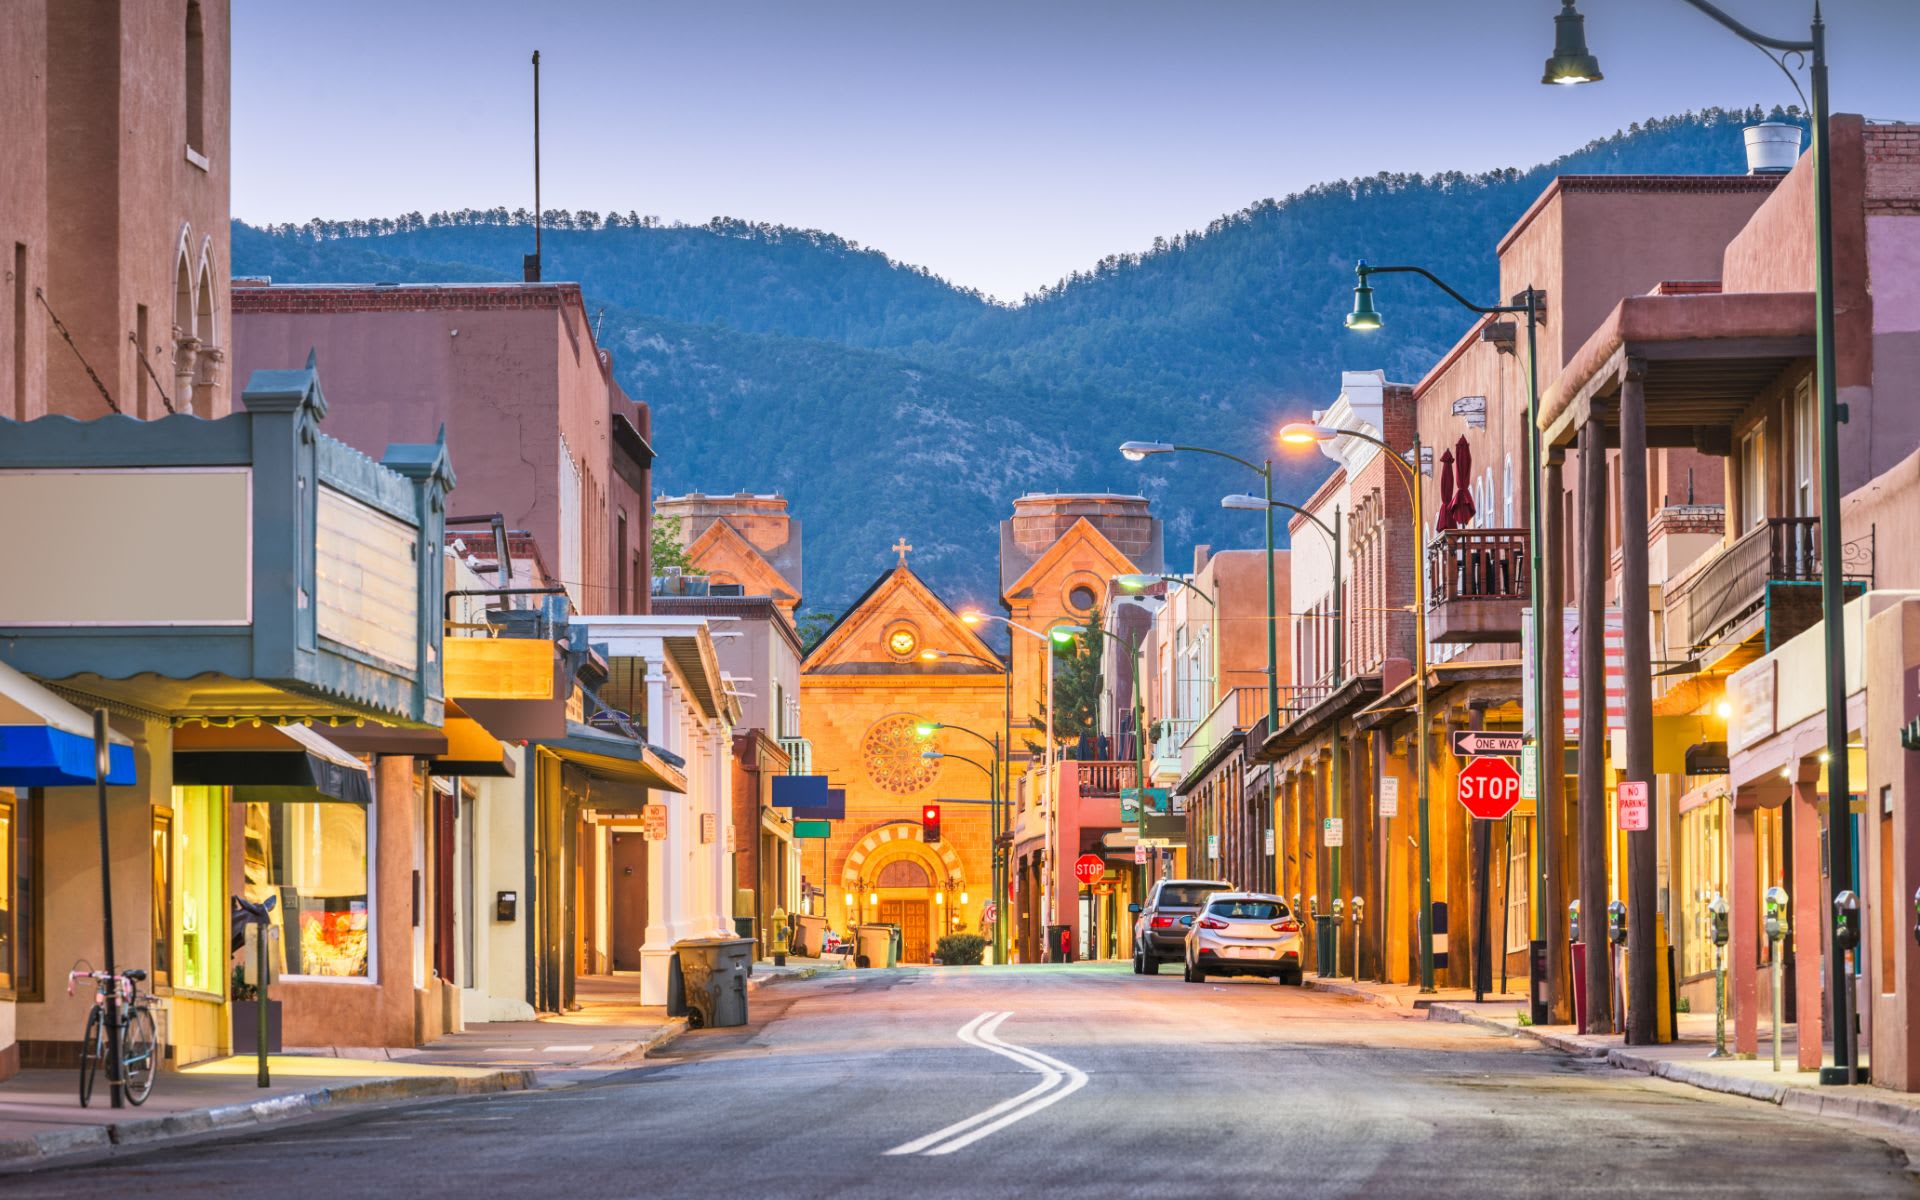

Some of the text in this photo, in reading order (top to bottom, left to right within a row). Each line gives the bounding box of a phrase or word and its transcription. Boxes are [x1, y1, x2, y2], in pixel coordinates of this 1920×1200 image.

[1475, 739, 1520, 750] ONE WAY
[1460, 776, 1519, 800] STOP
[1628, 787, 1639, 796] NO
[1619, 799, 1648, 808] PARKING
[650, 807, 660, 815] NO
[1076, 863, 1103, 875] STOP
